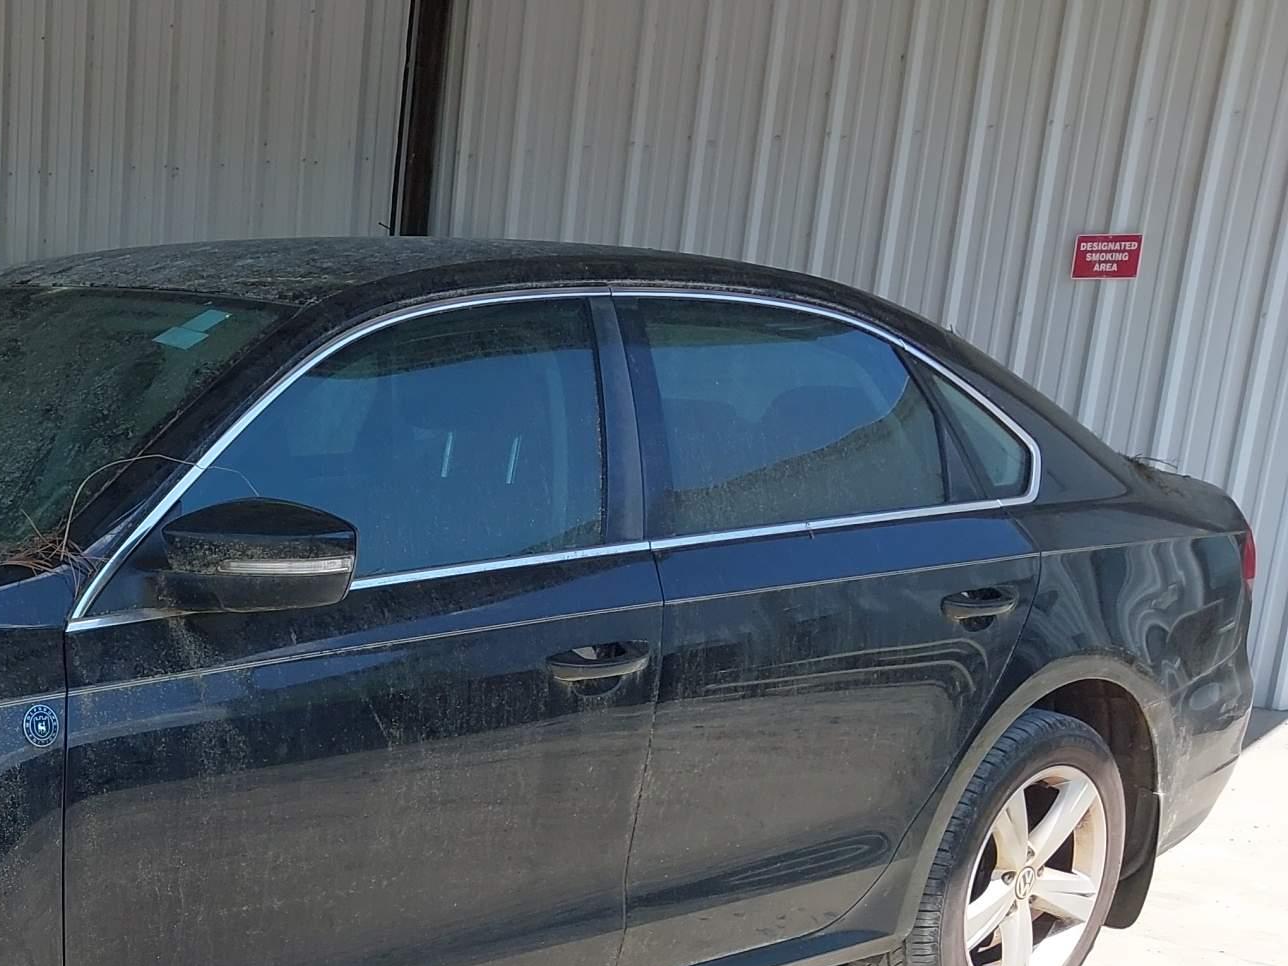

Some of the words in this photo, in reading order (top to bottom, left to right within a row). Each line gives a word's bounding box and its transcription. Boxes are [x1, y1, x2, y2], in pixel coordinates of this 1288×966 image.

[1080, 241, 1138, 251] DESIGNATED
[1085, 252, 1129, 261] SMOKING
[1093, 262, 1118, 272] AREA
